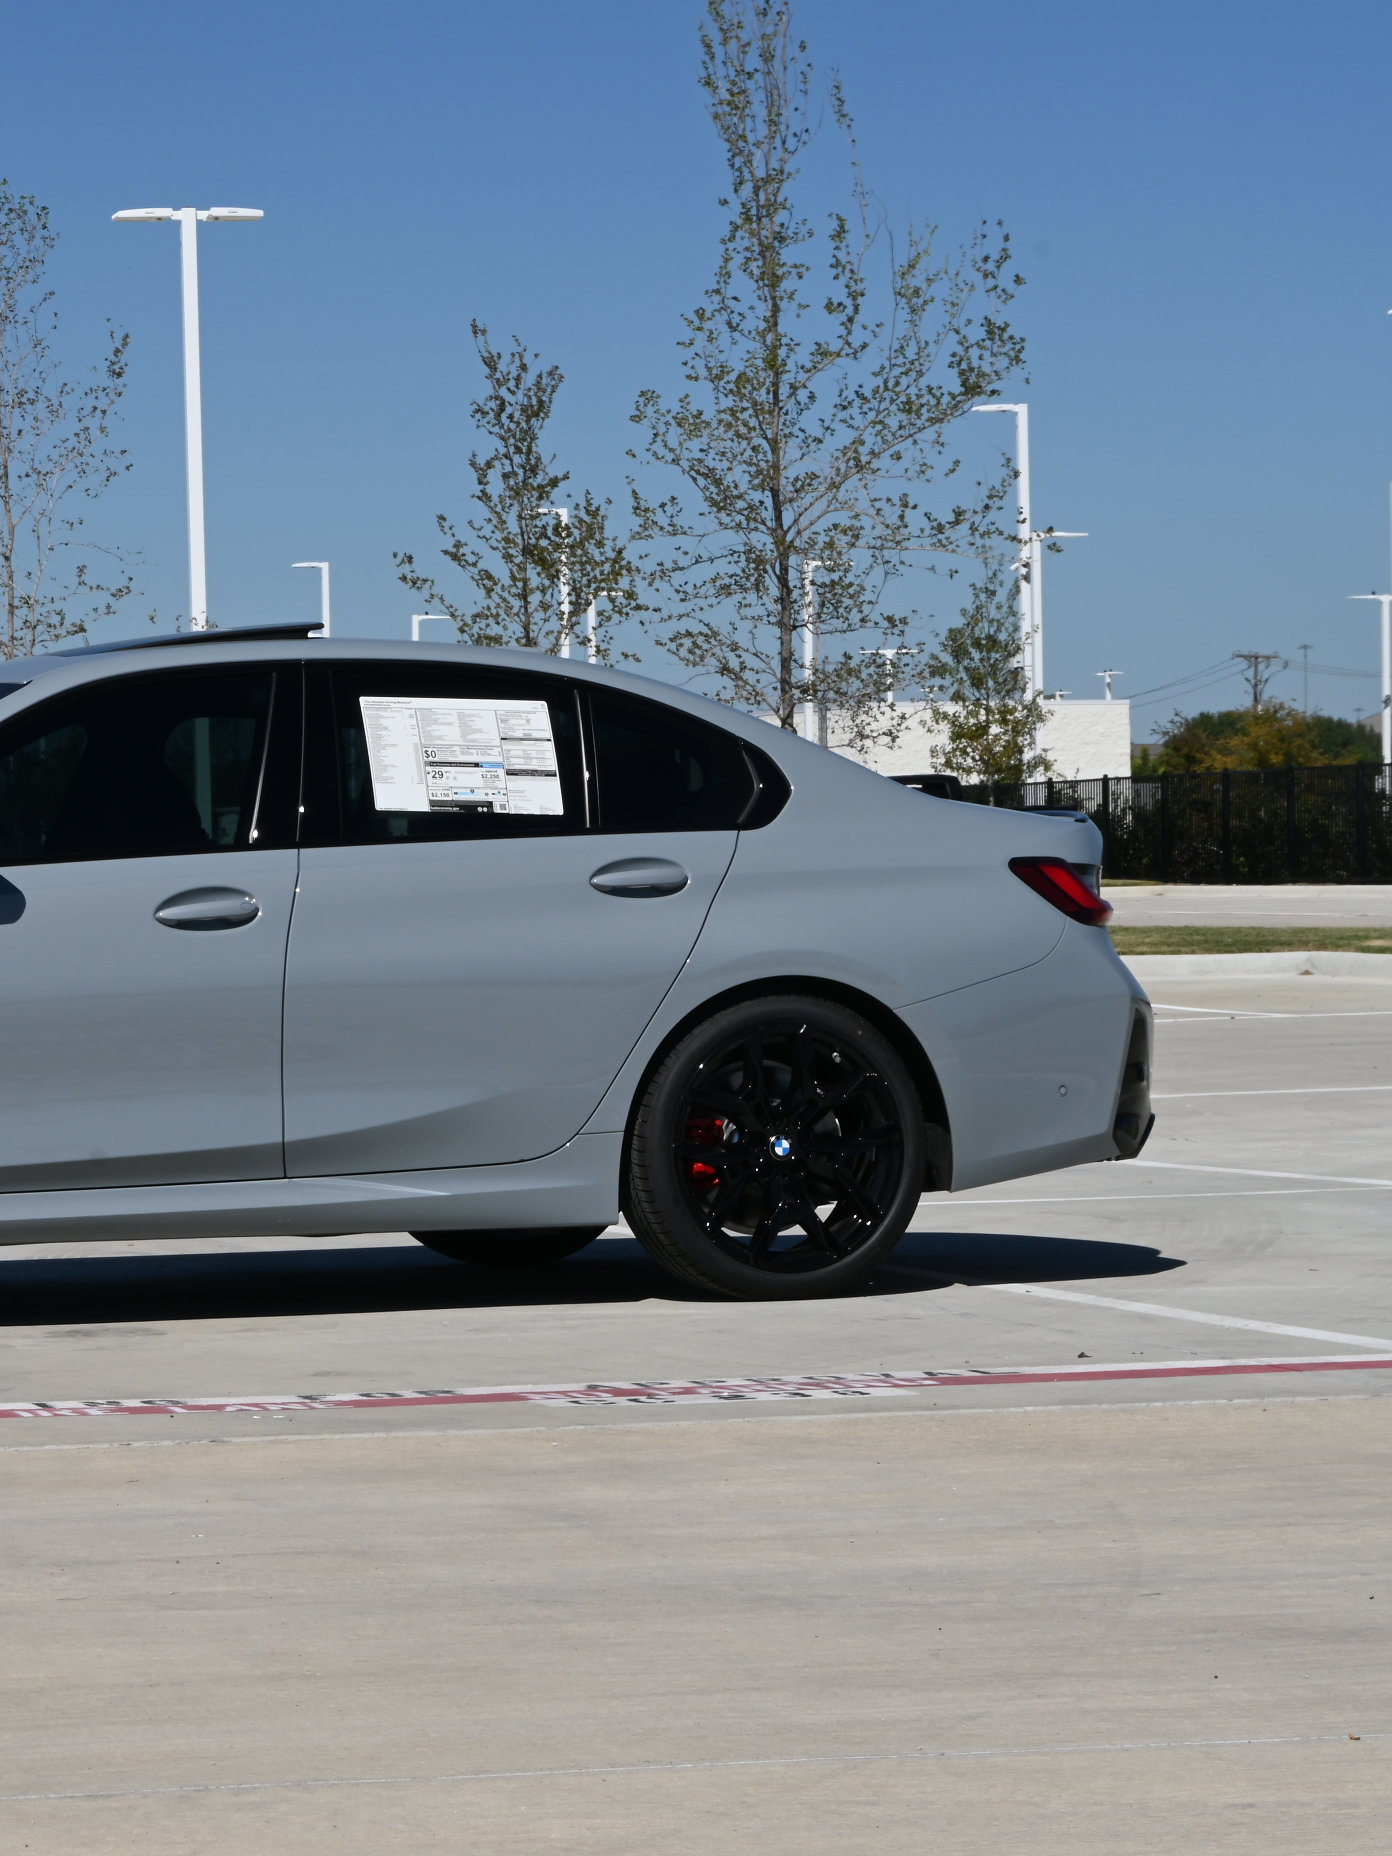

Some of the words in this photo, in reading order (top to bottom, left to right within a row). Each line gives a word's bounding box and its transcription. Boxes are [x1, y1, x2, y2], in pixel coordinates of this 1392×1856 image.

[424, 749, 437, 759] $0
[431, 770, 444, 779] 29
[166, 1401, 354, 1413] LANE
[518, 1391, 614, 1400] NO
[645, 1377, 940, 1396] PARKING
[296, 1389, 458, 1401] FOR
